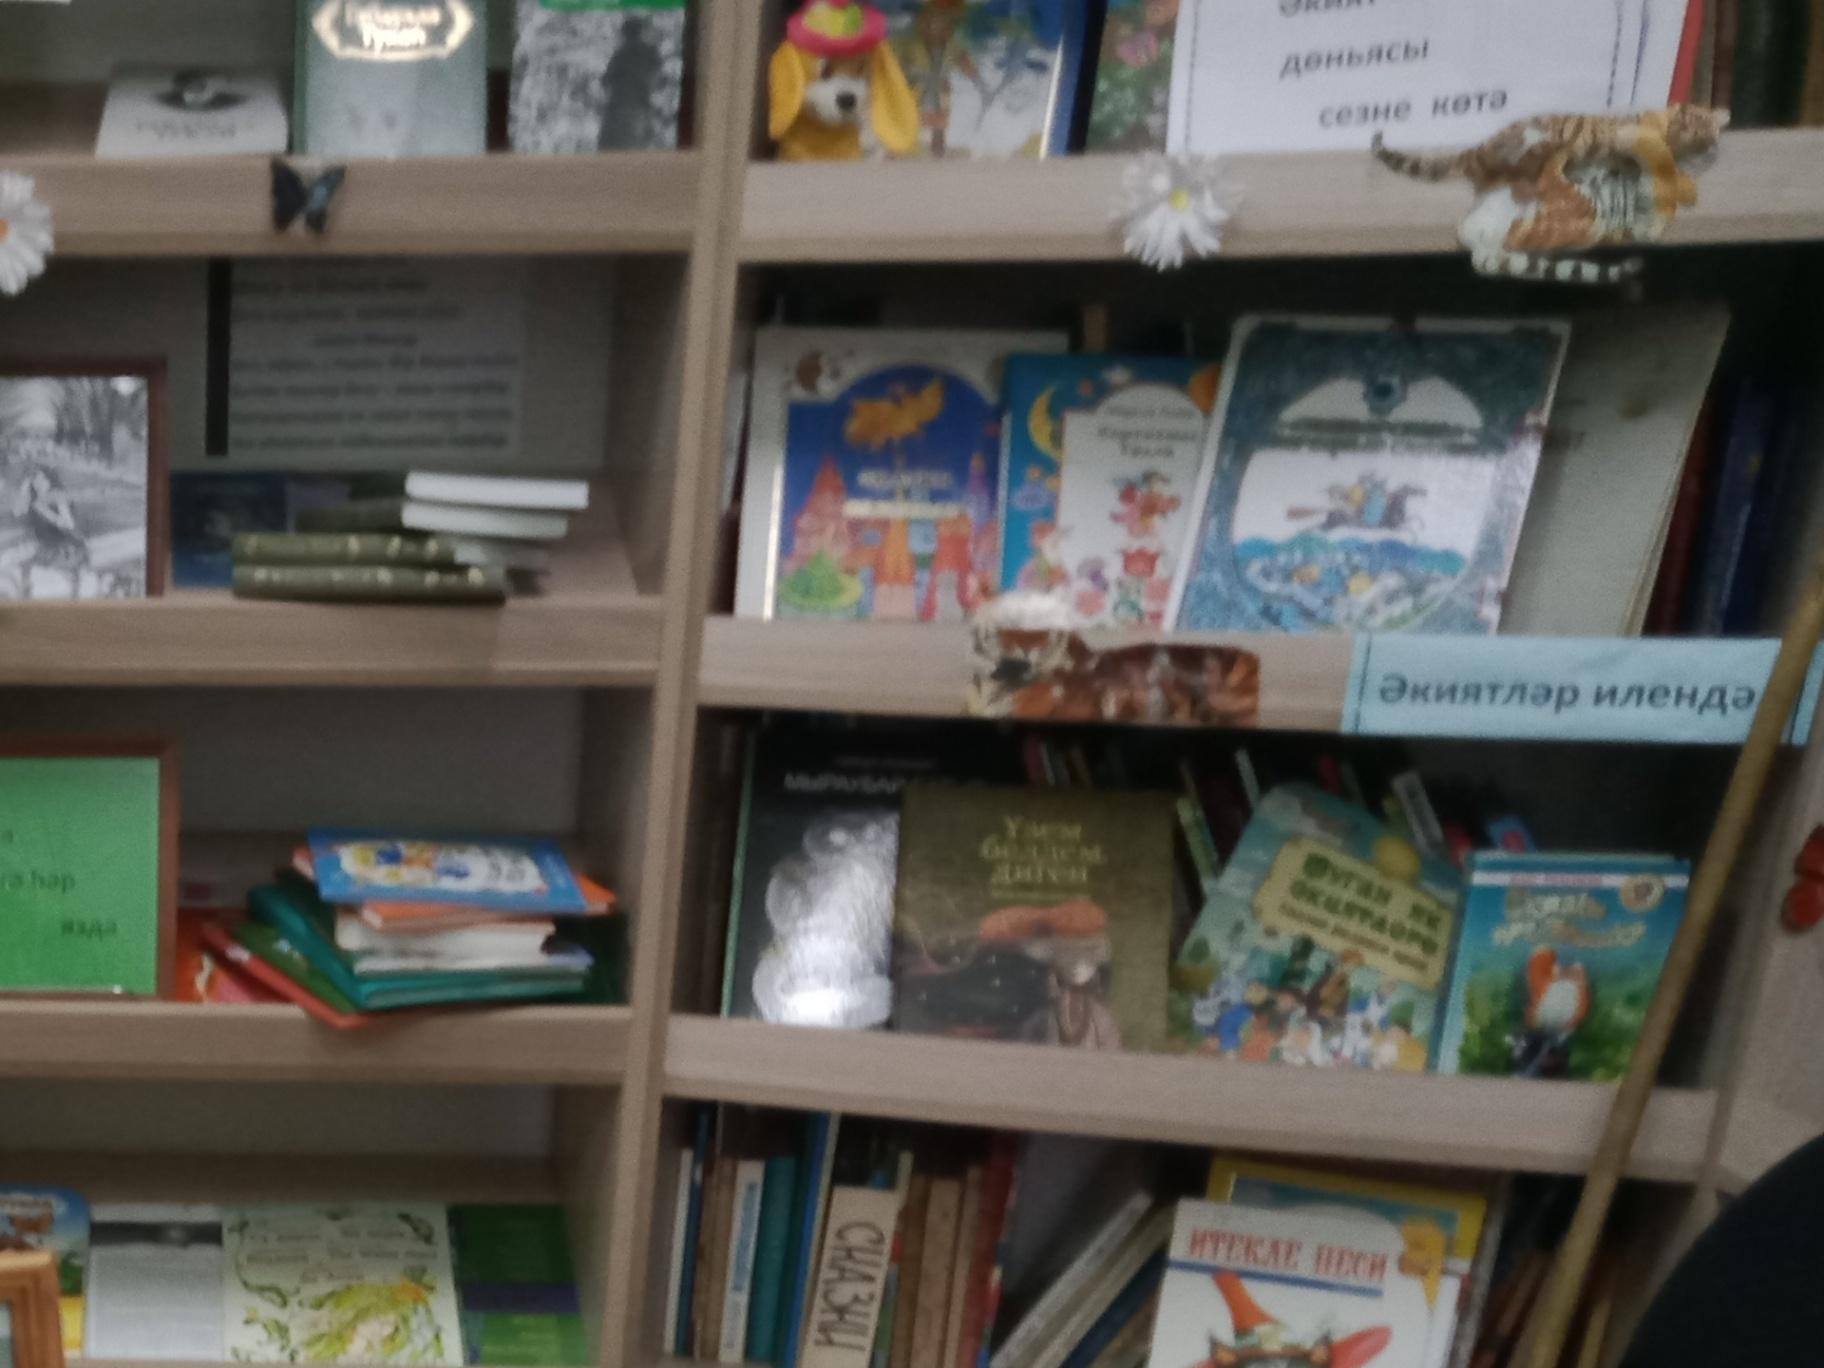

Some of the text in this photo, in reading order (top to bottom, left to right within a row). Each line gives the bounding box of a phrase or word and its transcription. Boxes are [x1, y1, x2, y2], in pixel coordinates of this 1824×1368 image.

[1279, 40, 1429, 79] дөньясы
[1319, 89, 1508, 128] сезне көтә
[1379, 672, 1757, 716] Әкиятләр илендә
